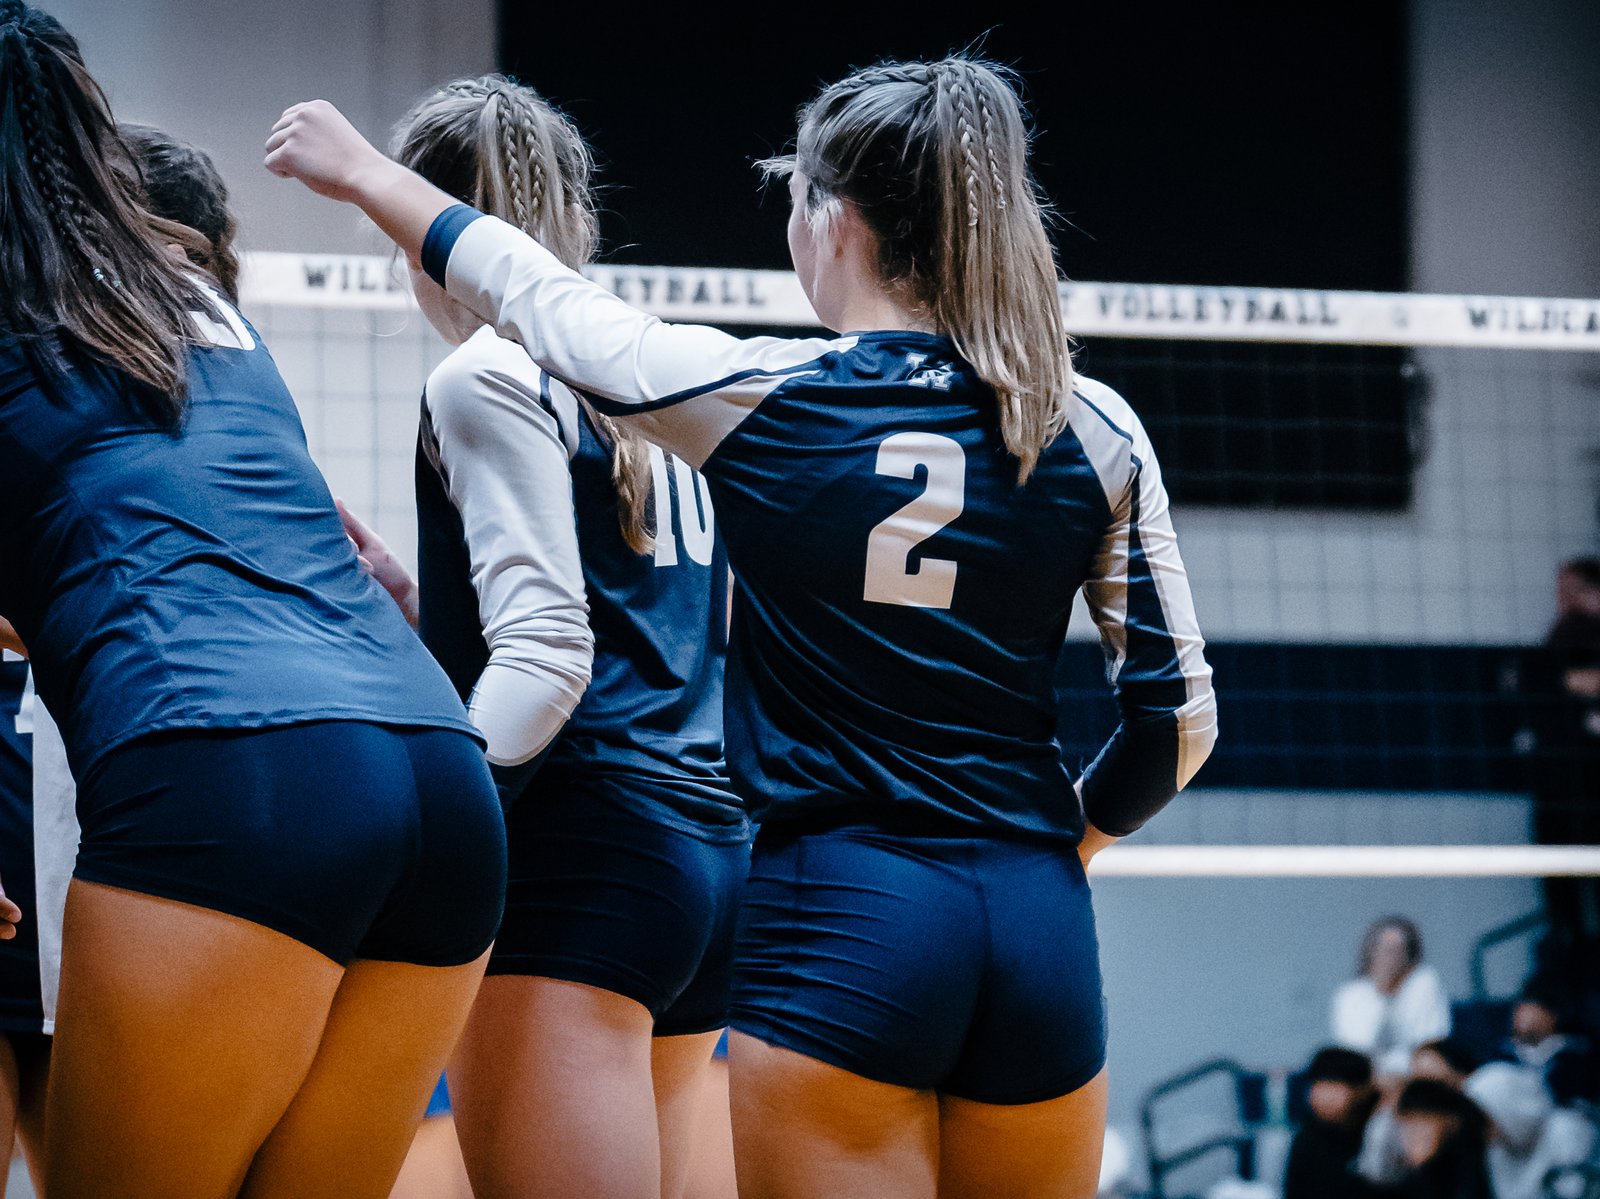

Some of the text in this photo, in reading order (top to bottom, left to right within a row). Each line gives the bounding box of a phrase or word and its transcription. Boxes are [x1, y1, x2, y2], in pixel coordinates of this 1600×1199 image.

[587, 275, 766, 305] EYBALL
[1098, 293, 1338, 325] VOLLEYBALL
[648, 440, 714, 567] 10
[863, 431, 966, 609] 2
